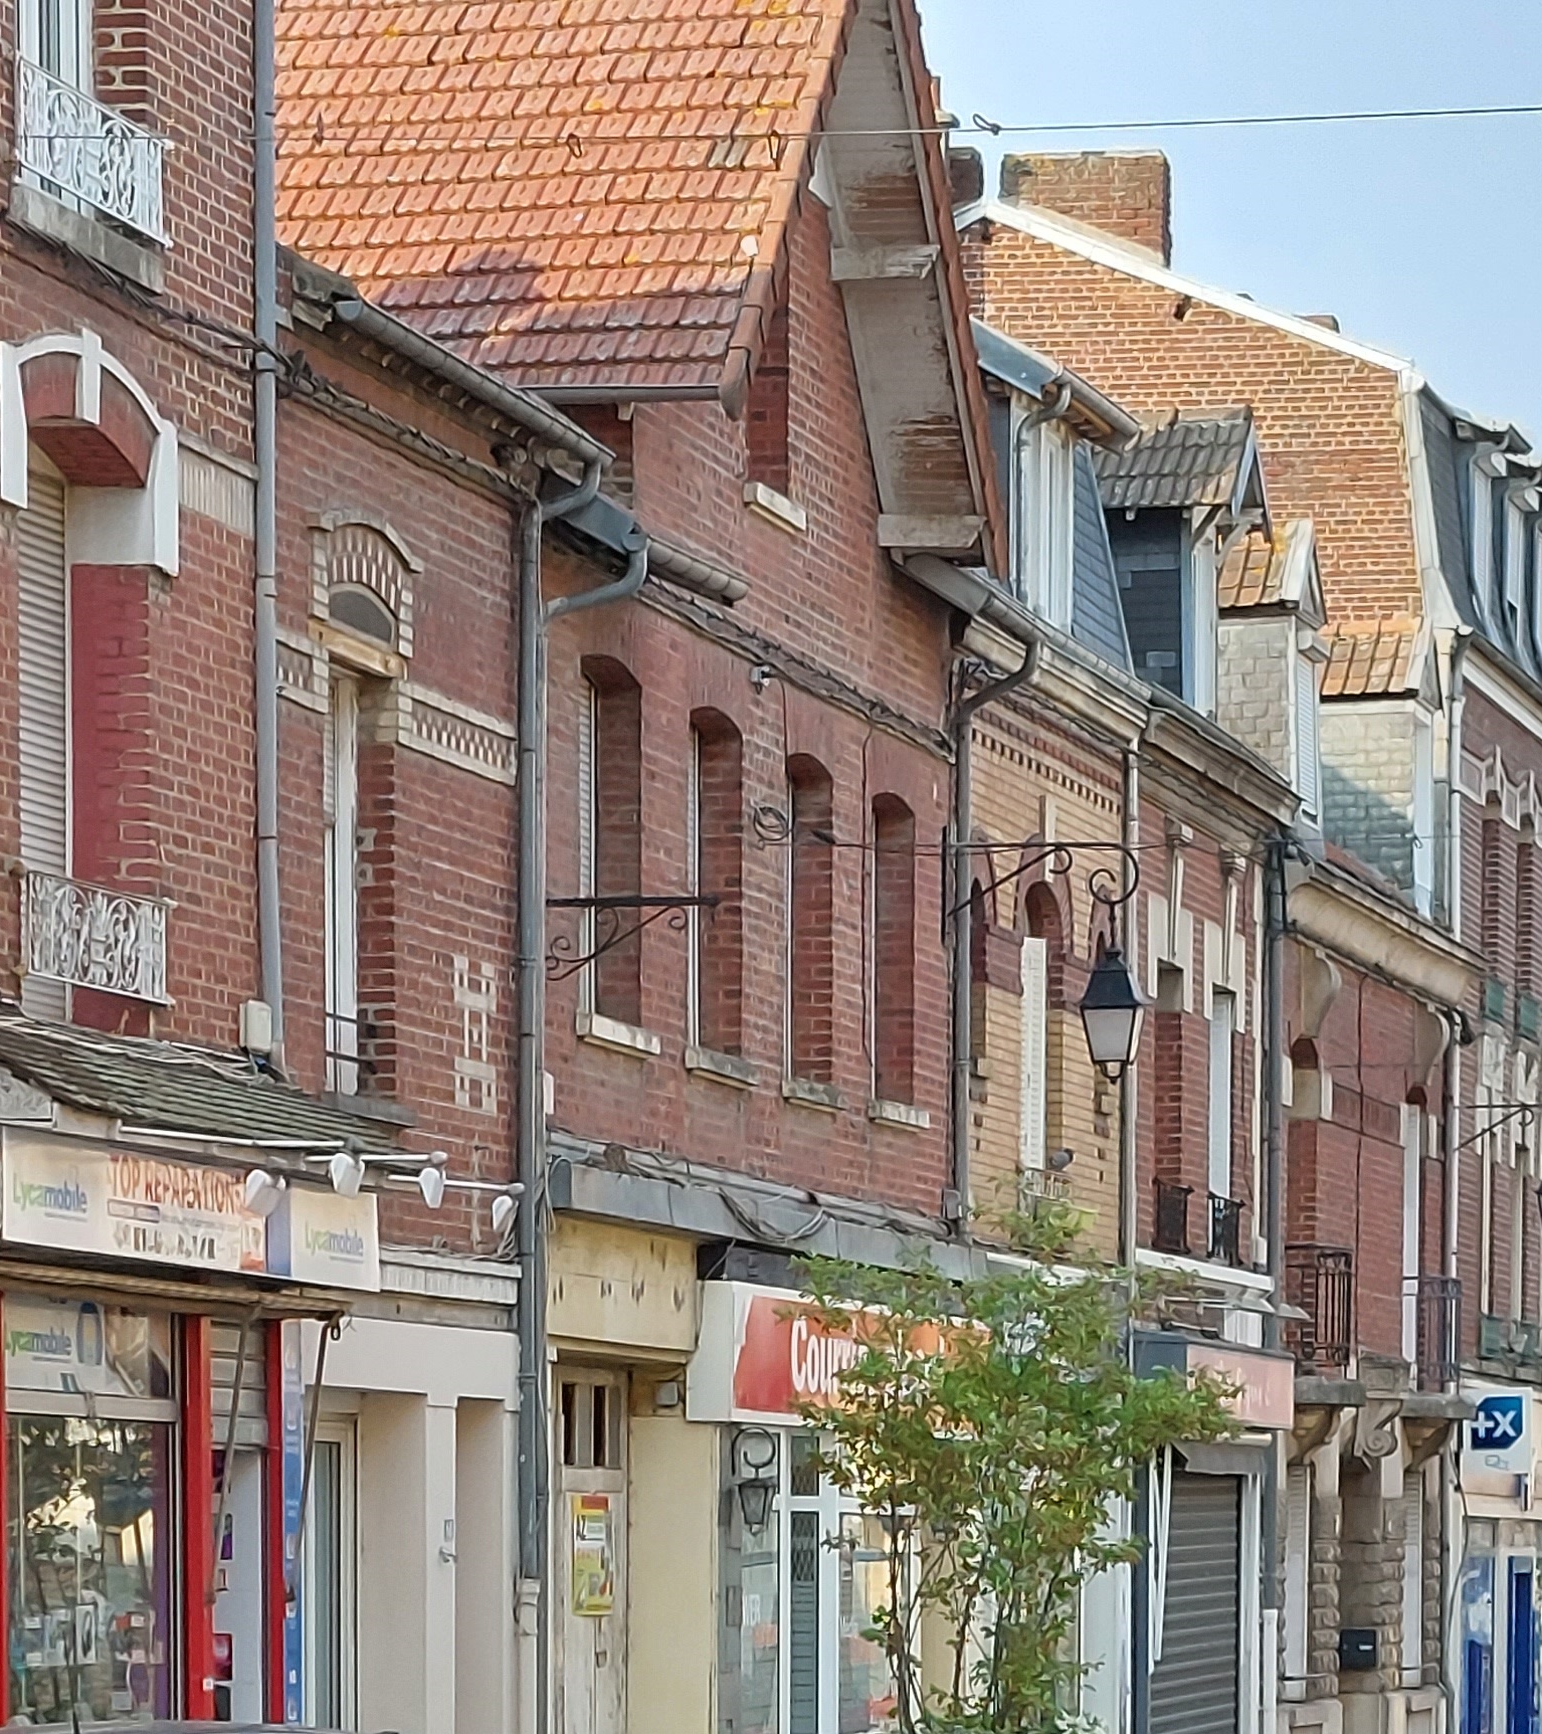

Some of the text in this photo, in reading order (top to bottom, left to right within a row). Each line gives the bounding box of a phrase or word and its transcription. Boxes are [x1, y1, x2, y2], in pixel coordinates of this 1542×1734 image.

[13, 1171, 89, 1214] Lycamobile
[110, 1155, 141, 1199] TOP
[304, 1219, 364, 1257] Lycamobile
